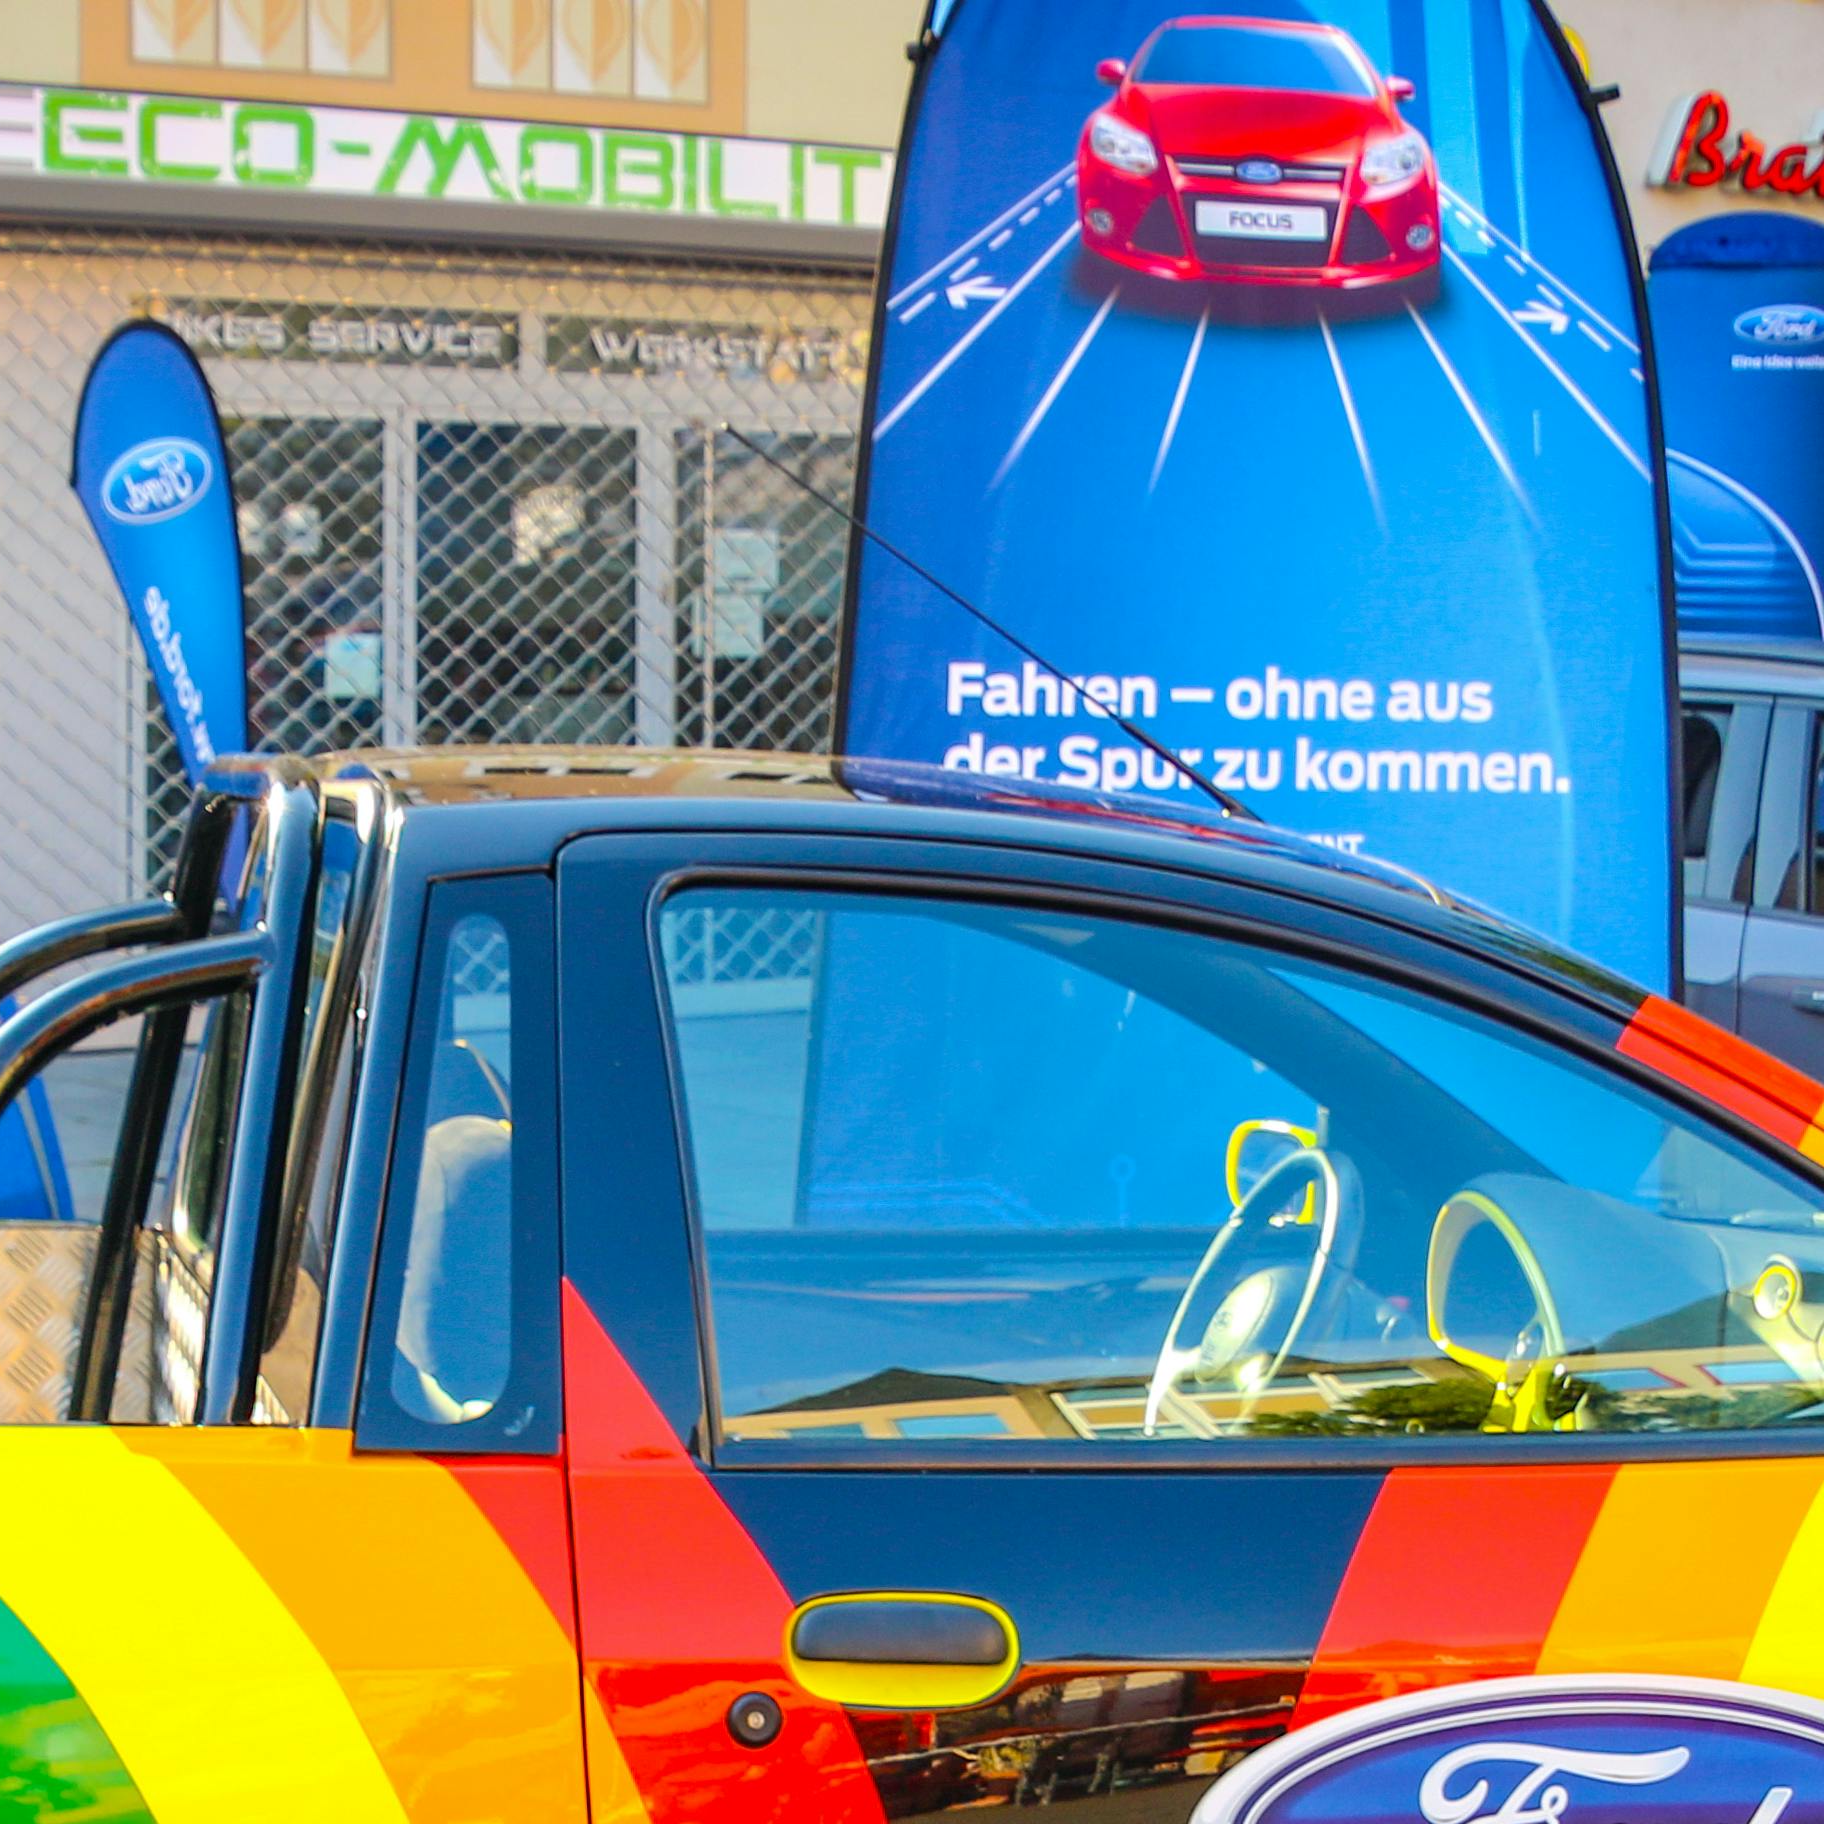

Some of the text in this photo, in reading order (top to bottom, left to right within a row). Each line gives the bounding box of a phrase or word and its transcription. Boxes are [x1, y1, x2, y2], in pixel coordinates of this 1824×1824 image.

[1228, 210, 1294, 230] FOCUS
[945, 661, 1158, 719] Fahren
[1224, 666, 1375, 722] ohne
[1385, 679, 1495, 723] aus
[1057, 735, 1213, 794] Spur
[1212, 744, 1282, 790] zu
[1294, 737, 1572, 794] kommen.
